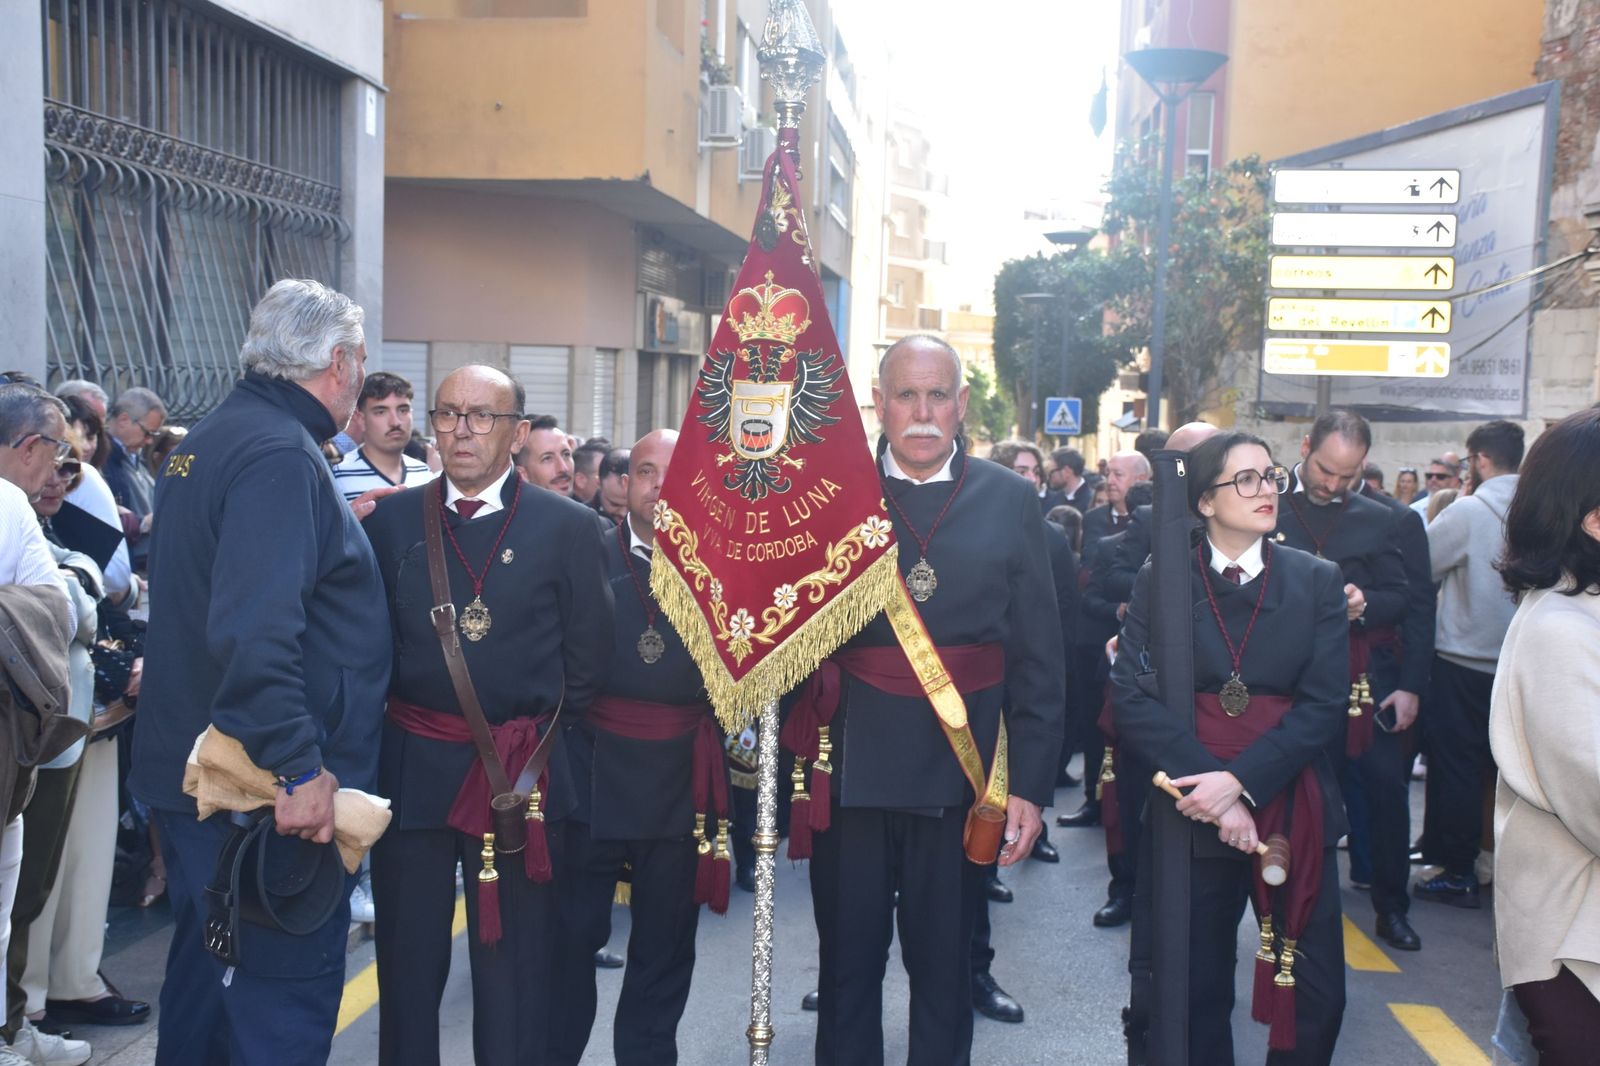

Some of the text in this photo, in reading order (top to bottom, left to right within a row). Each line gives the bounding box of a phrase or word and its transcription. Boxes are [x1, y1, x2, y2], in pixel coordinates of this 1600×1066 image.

[691, 469, 843, 534] VIRGEN DE LUNA
[726, 539, 742, 561] DE
[746, 530, 819, 562] CORDOBA
